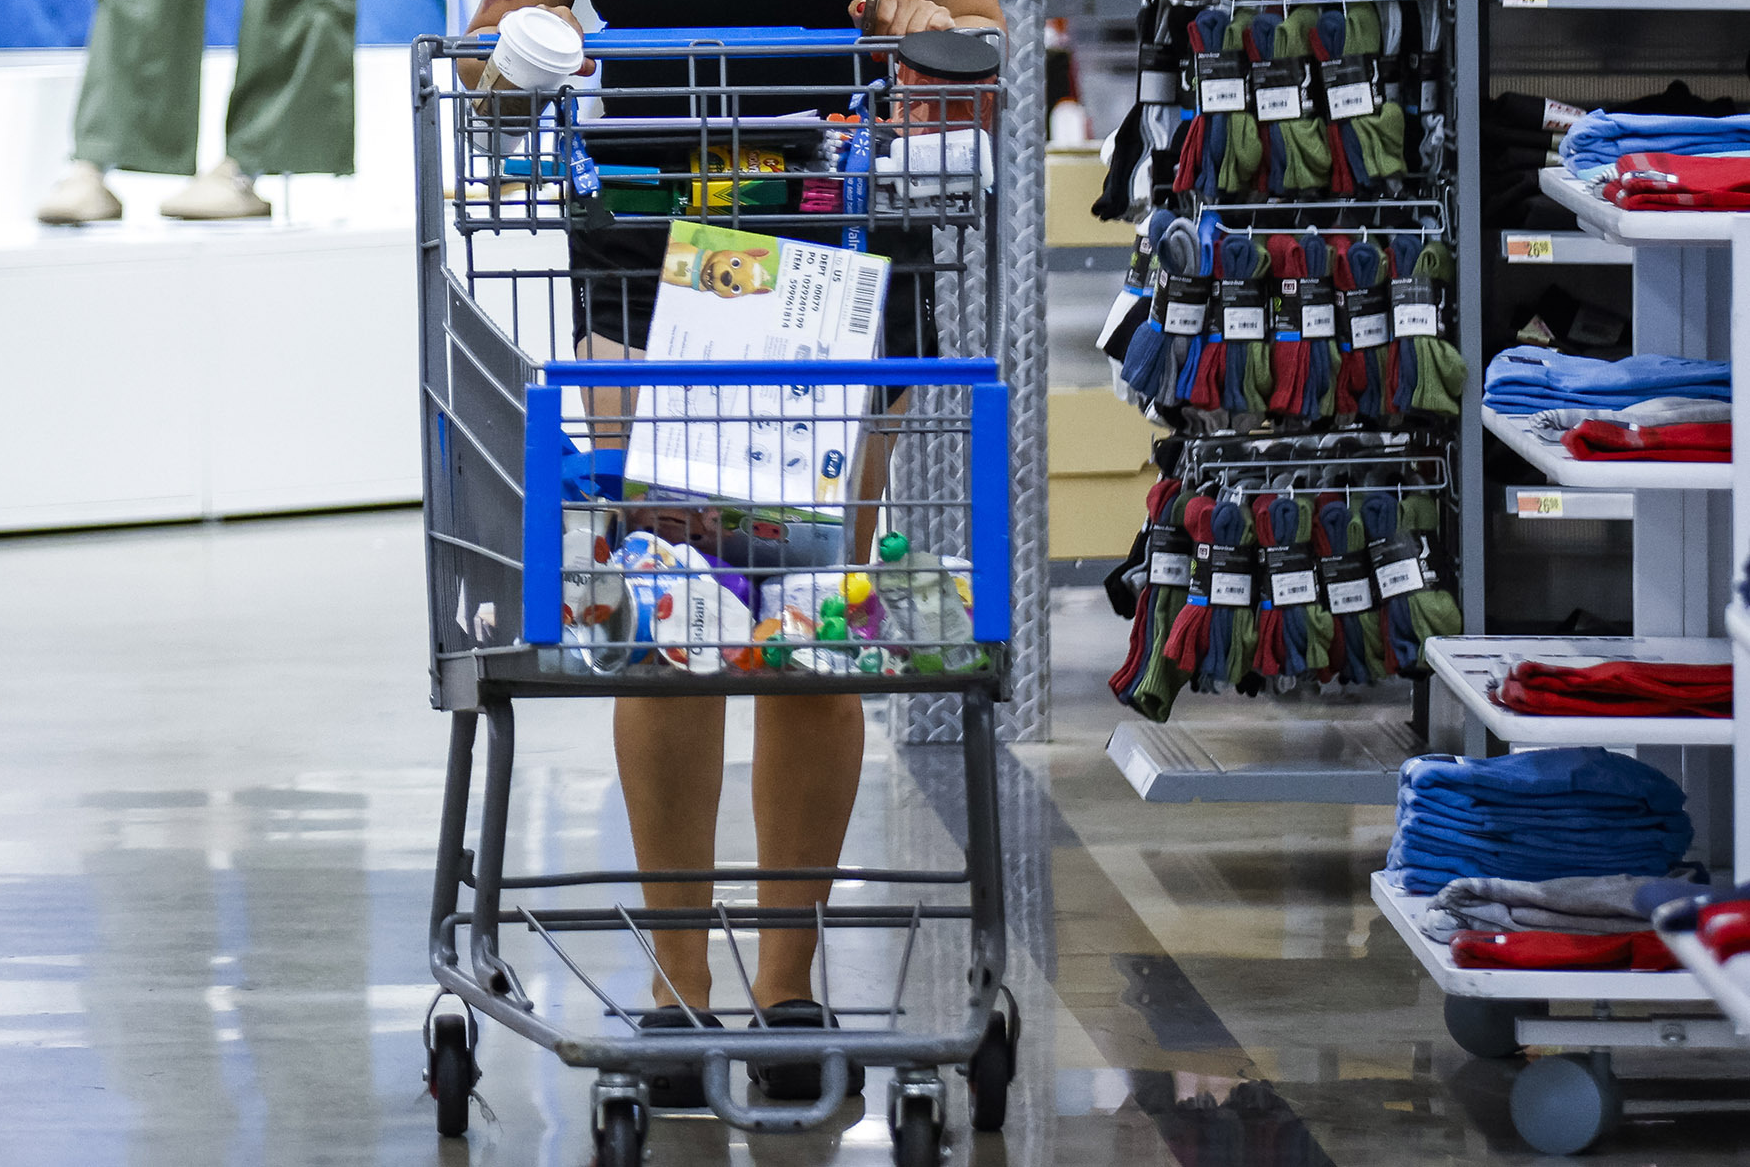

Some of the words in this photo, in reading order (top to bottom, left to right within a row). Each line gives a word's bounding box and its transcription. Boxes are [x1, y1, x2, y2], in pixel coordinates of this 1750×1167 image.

[792, 249, 803, 271] ITEM
[807, 251, 816, 265] PO
[818, 253, 829, 277] DEPT
[832, 270, 842, 283] US
[810, 284, 823, 312] 00079
[690, 597, 705, 656] Cobani
